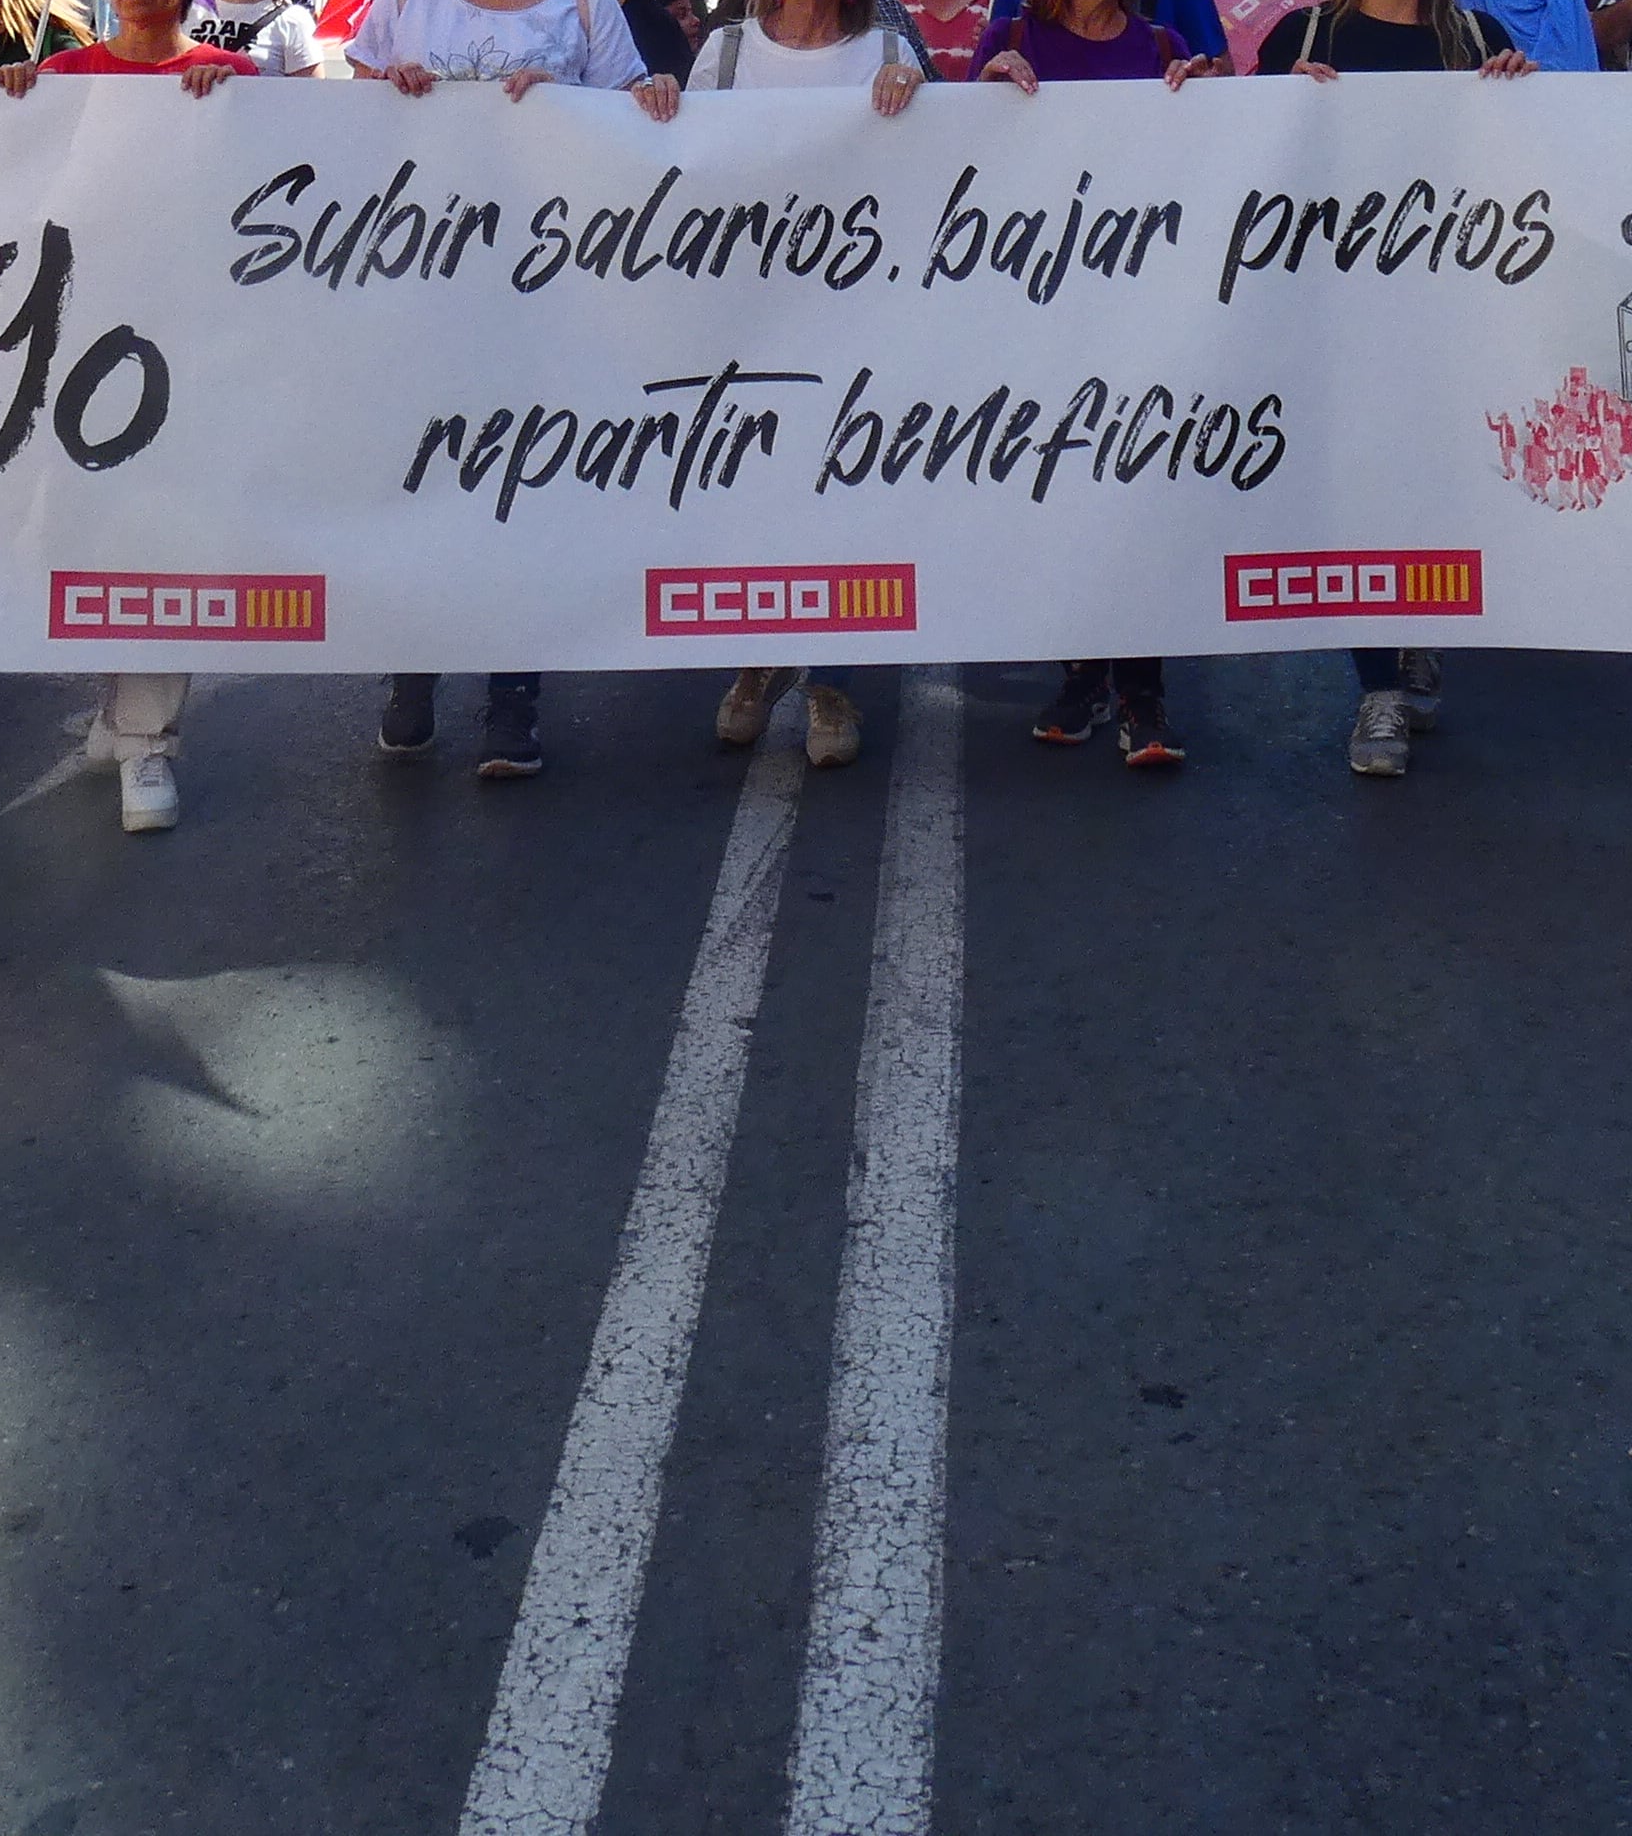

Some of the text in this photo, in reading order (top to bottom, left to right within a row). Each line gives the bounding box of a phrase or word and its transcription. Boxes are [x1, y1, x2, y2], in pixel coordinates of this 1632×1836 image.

[229, 159, 501, 291] Subir
[921, 164, 1183, 306] bajar
[1217, 178, 1556, 305] precios
[402, 359, 1286, 525] repartir beneficios
[64, 584, 237, 628] CCOO
[660, 579, 830, 624] CCOO
[1238, 563, 1398, 607] CCOO
